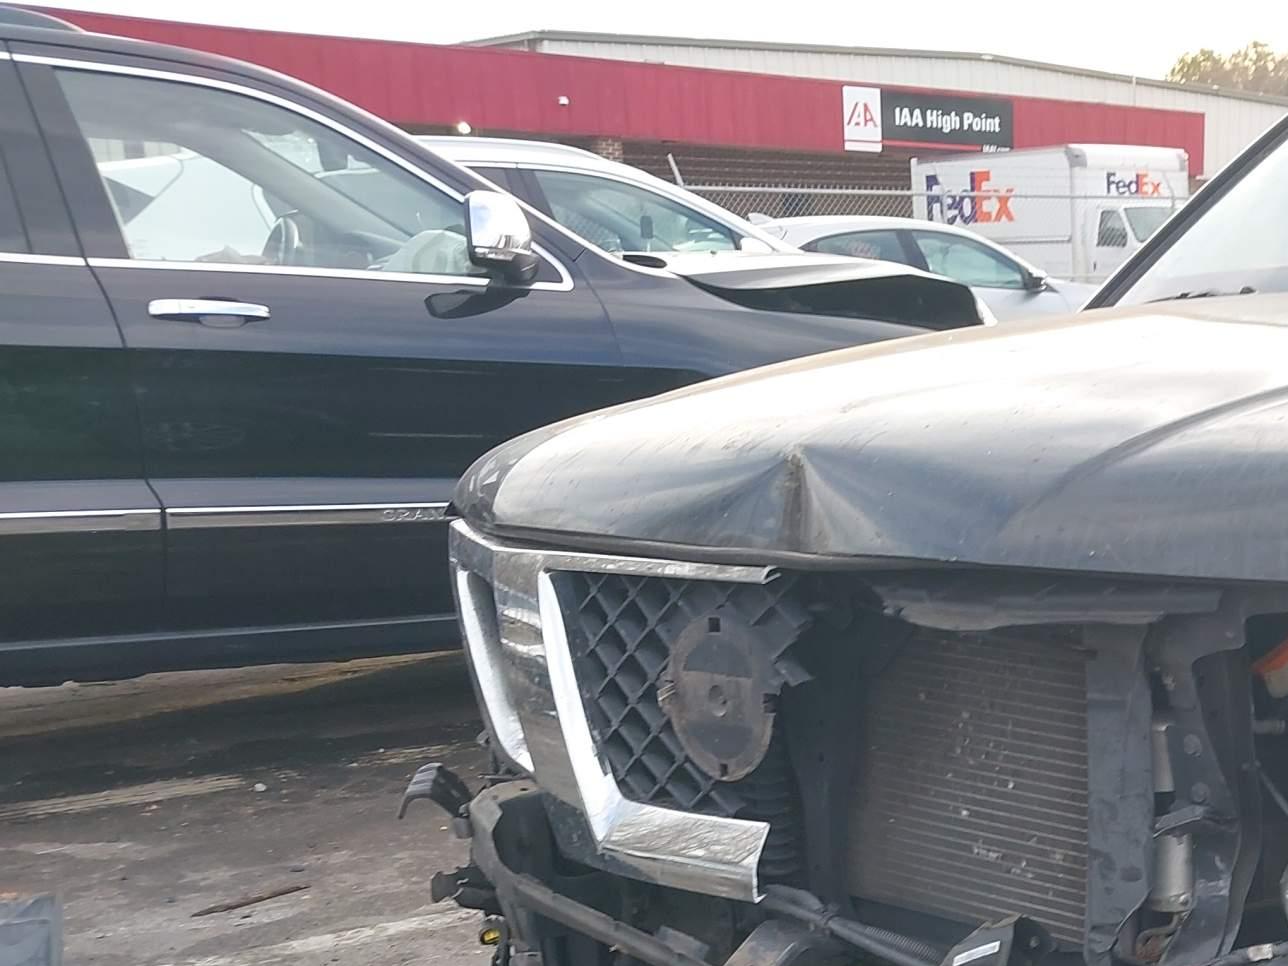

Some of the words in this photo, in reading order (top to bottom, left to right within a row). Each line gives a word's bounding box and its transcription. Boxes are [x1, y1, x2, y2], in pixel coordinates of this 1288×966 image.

[894, 106, 923, 127] IAA
[925, 108, 960, 133] High
[962, 111, 1000, 133] Point
[1106, 171, 1161, 196] FedEx
[925, 170, 1015, 225] FedEx
[383, 508, 448, 521] GRAN
